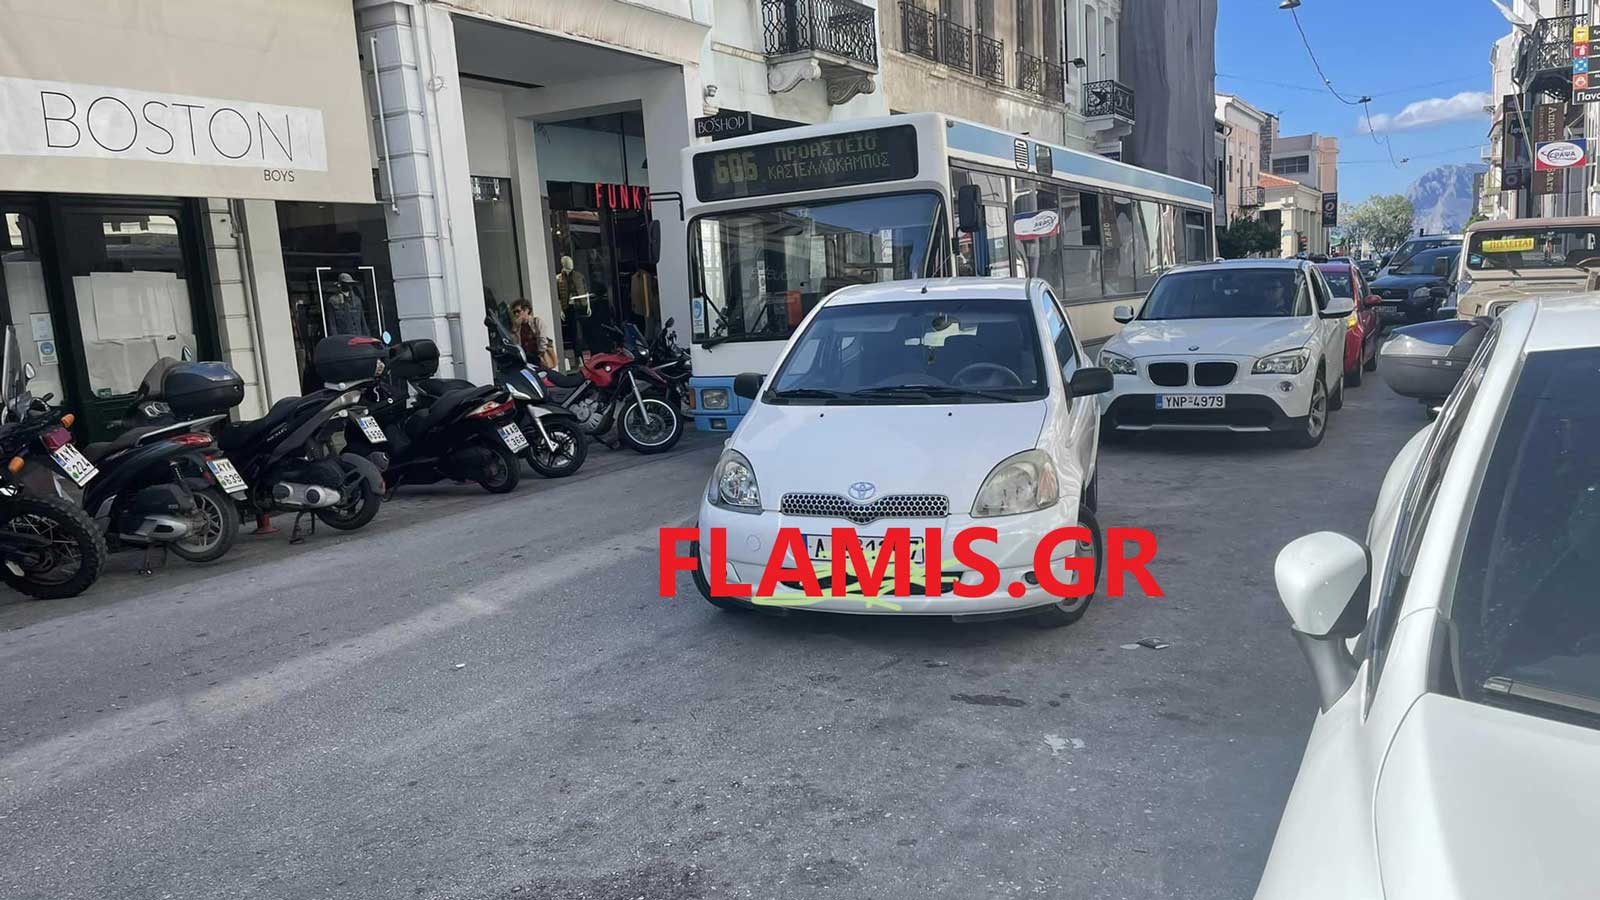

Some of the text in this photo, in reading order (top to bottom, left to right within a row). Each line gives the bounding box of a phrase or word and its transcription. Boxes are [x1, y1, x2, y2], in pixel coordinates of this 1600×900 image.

[40, 90, 293, 162] BOSTON
[1547, 106, 1558, 142] Americ
[774, 132, 878, 161] ΠΡΟΑΣΤΕΙΟ
[263, 169, 295, 182] BOYS
[767, 151, 891, 180] ΚΑΣΤΕΛΛΟΚΑΜΠΟΣ
